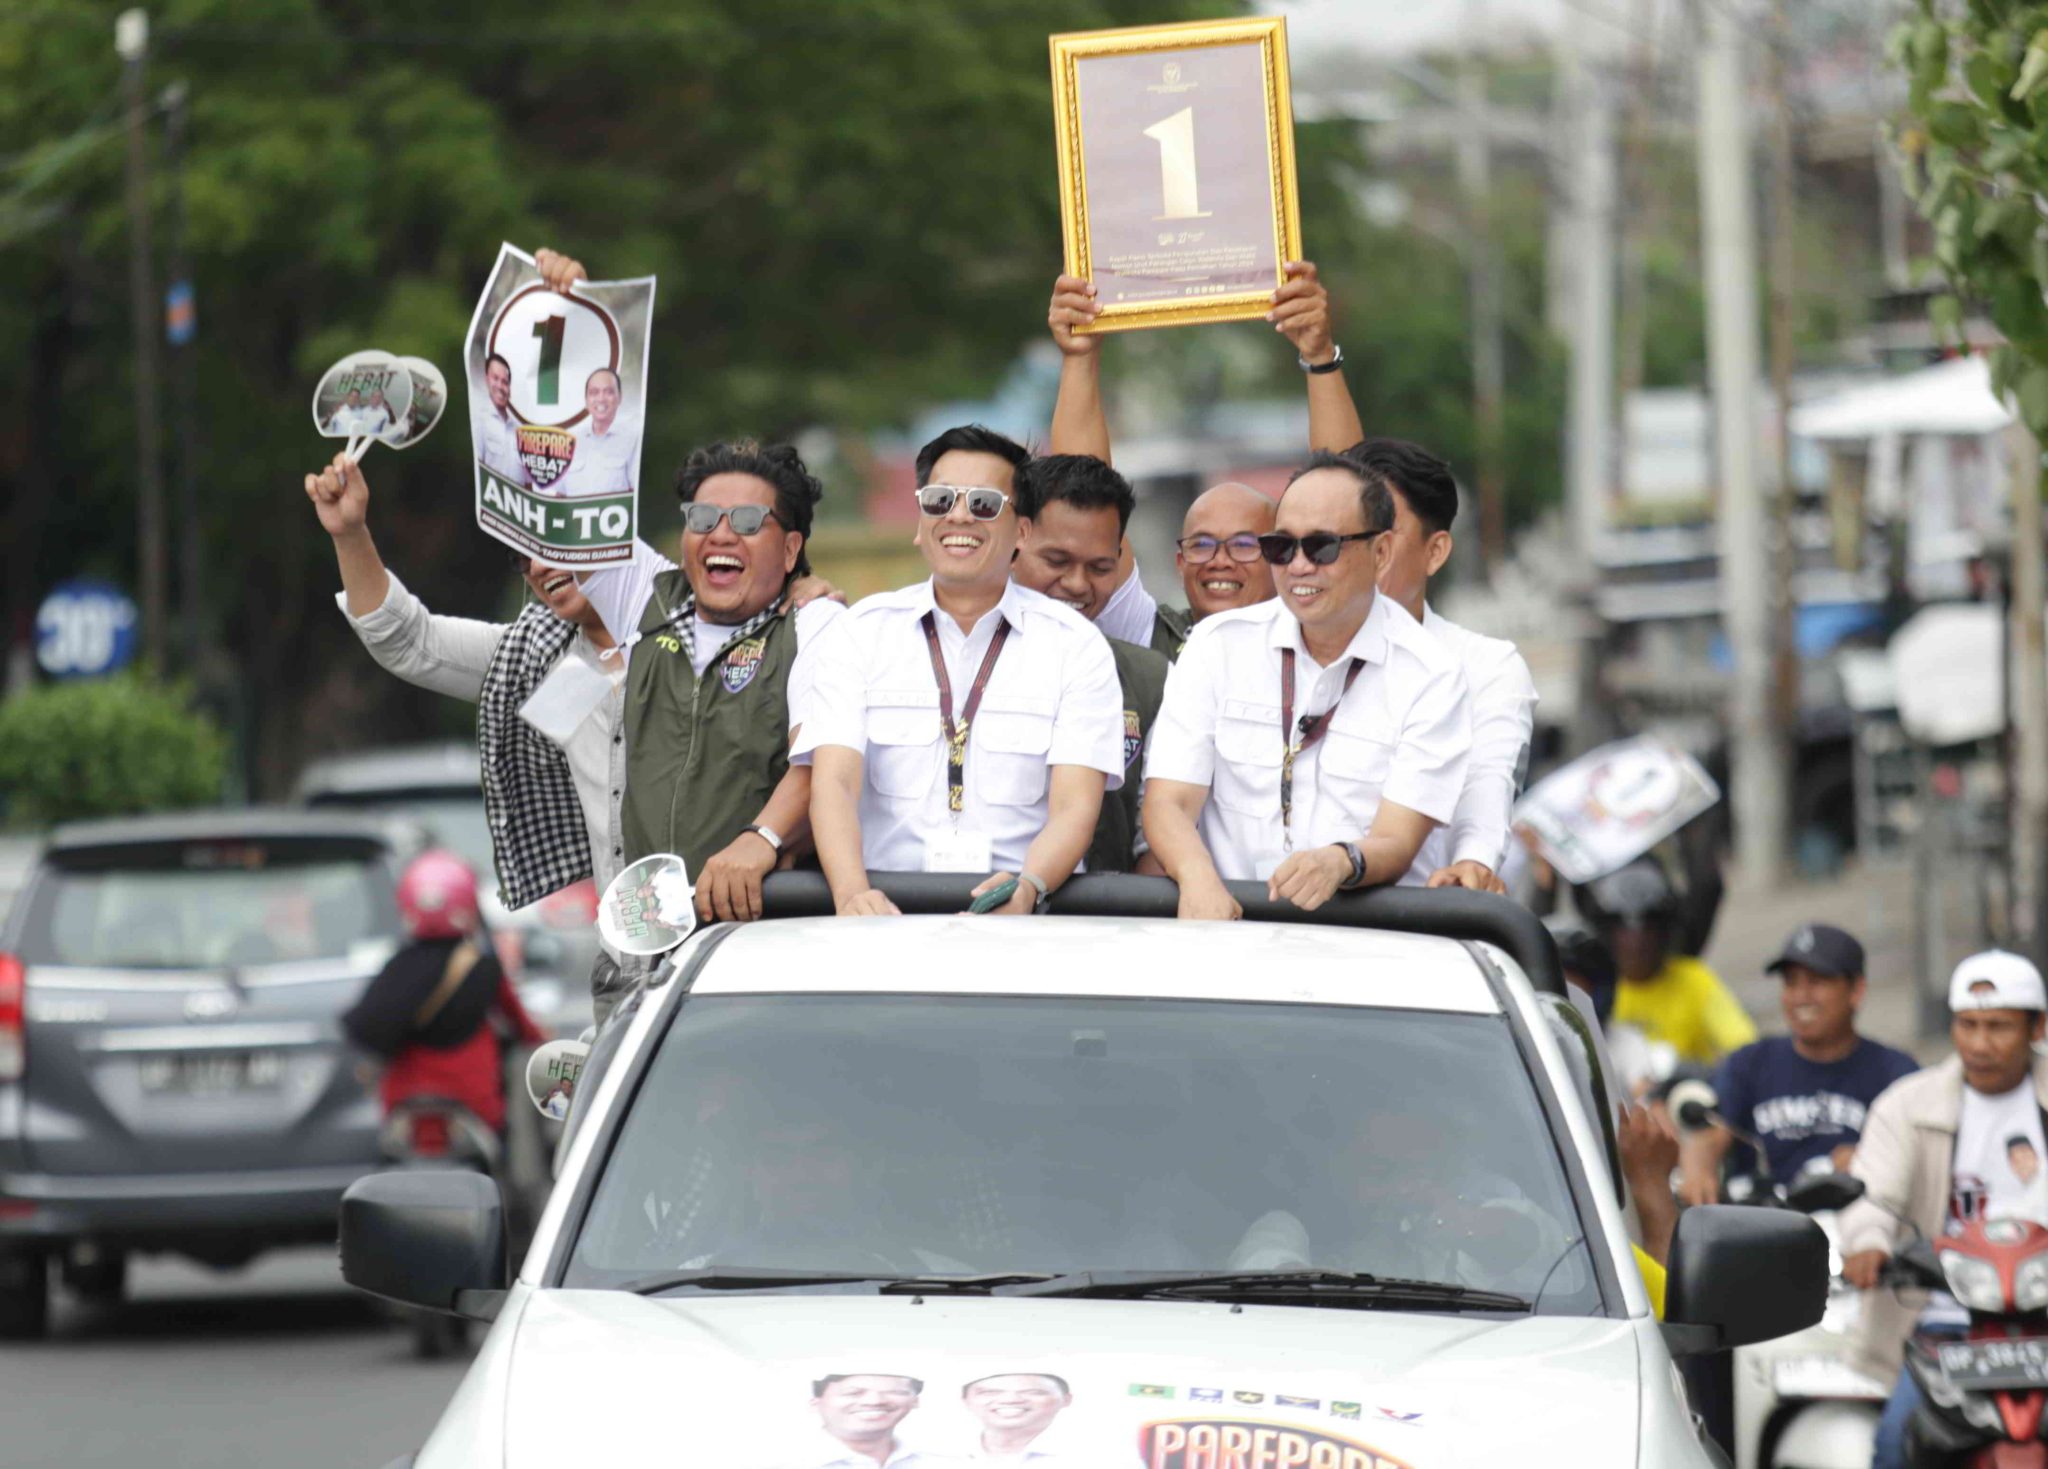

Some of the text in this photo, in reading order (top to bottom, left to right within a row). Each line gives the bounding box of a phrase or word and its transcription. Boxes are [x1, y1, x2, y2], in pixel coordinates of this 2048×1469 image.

[1142, 106, 1213, 220] 1
[336, 369, 398, 393] HEBAT
[532, 314, 566, 405] 1
[518, 430, 575, 460] PAREPARE
[521, 453, 567, 475] HEBAT
[483, 476, 547, 536] ANH
[572, 505, 629, 540] TQ
